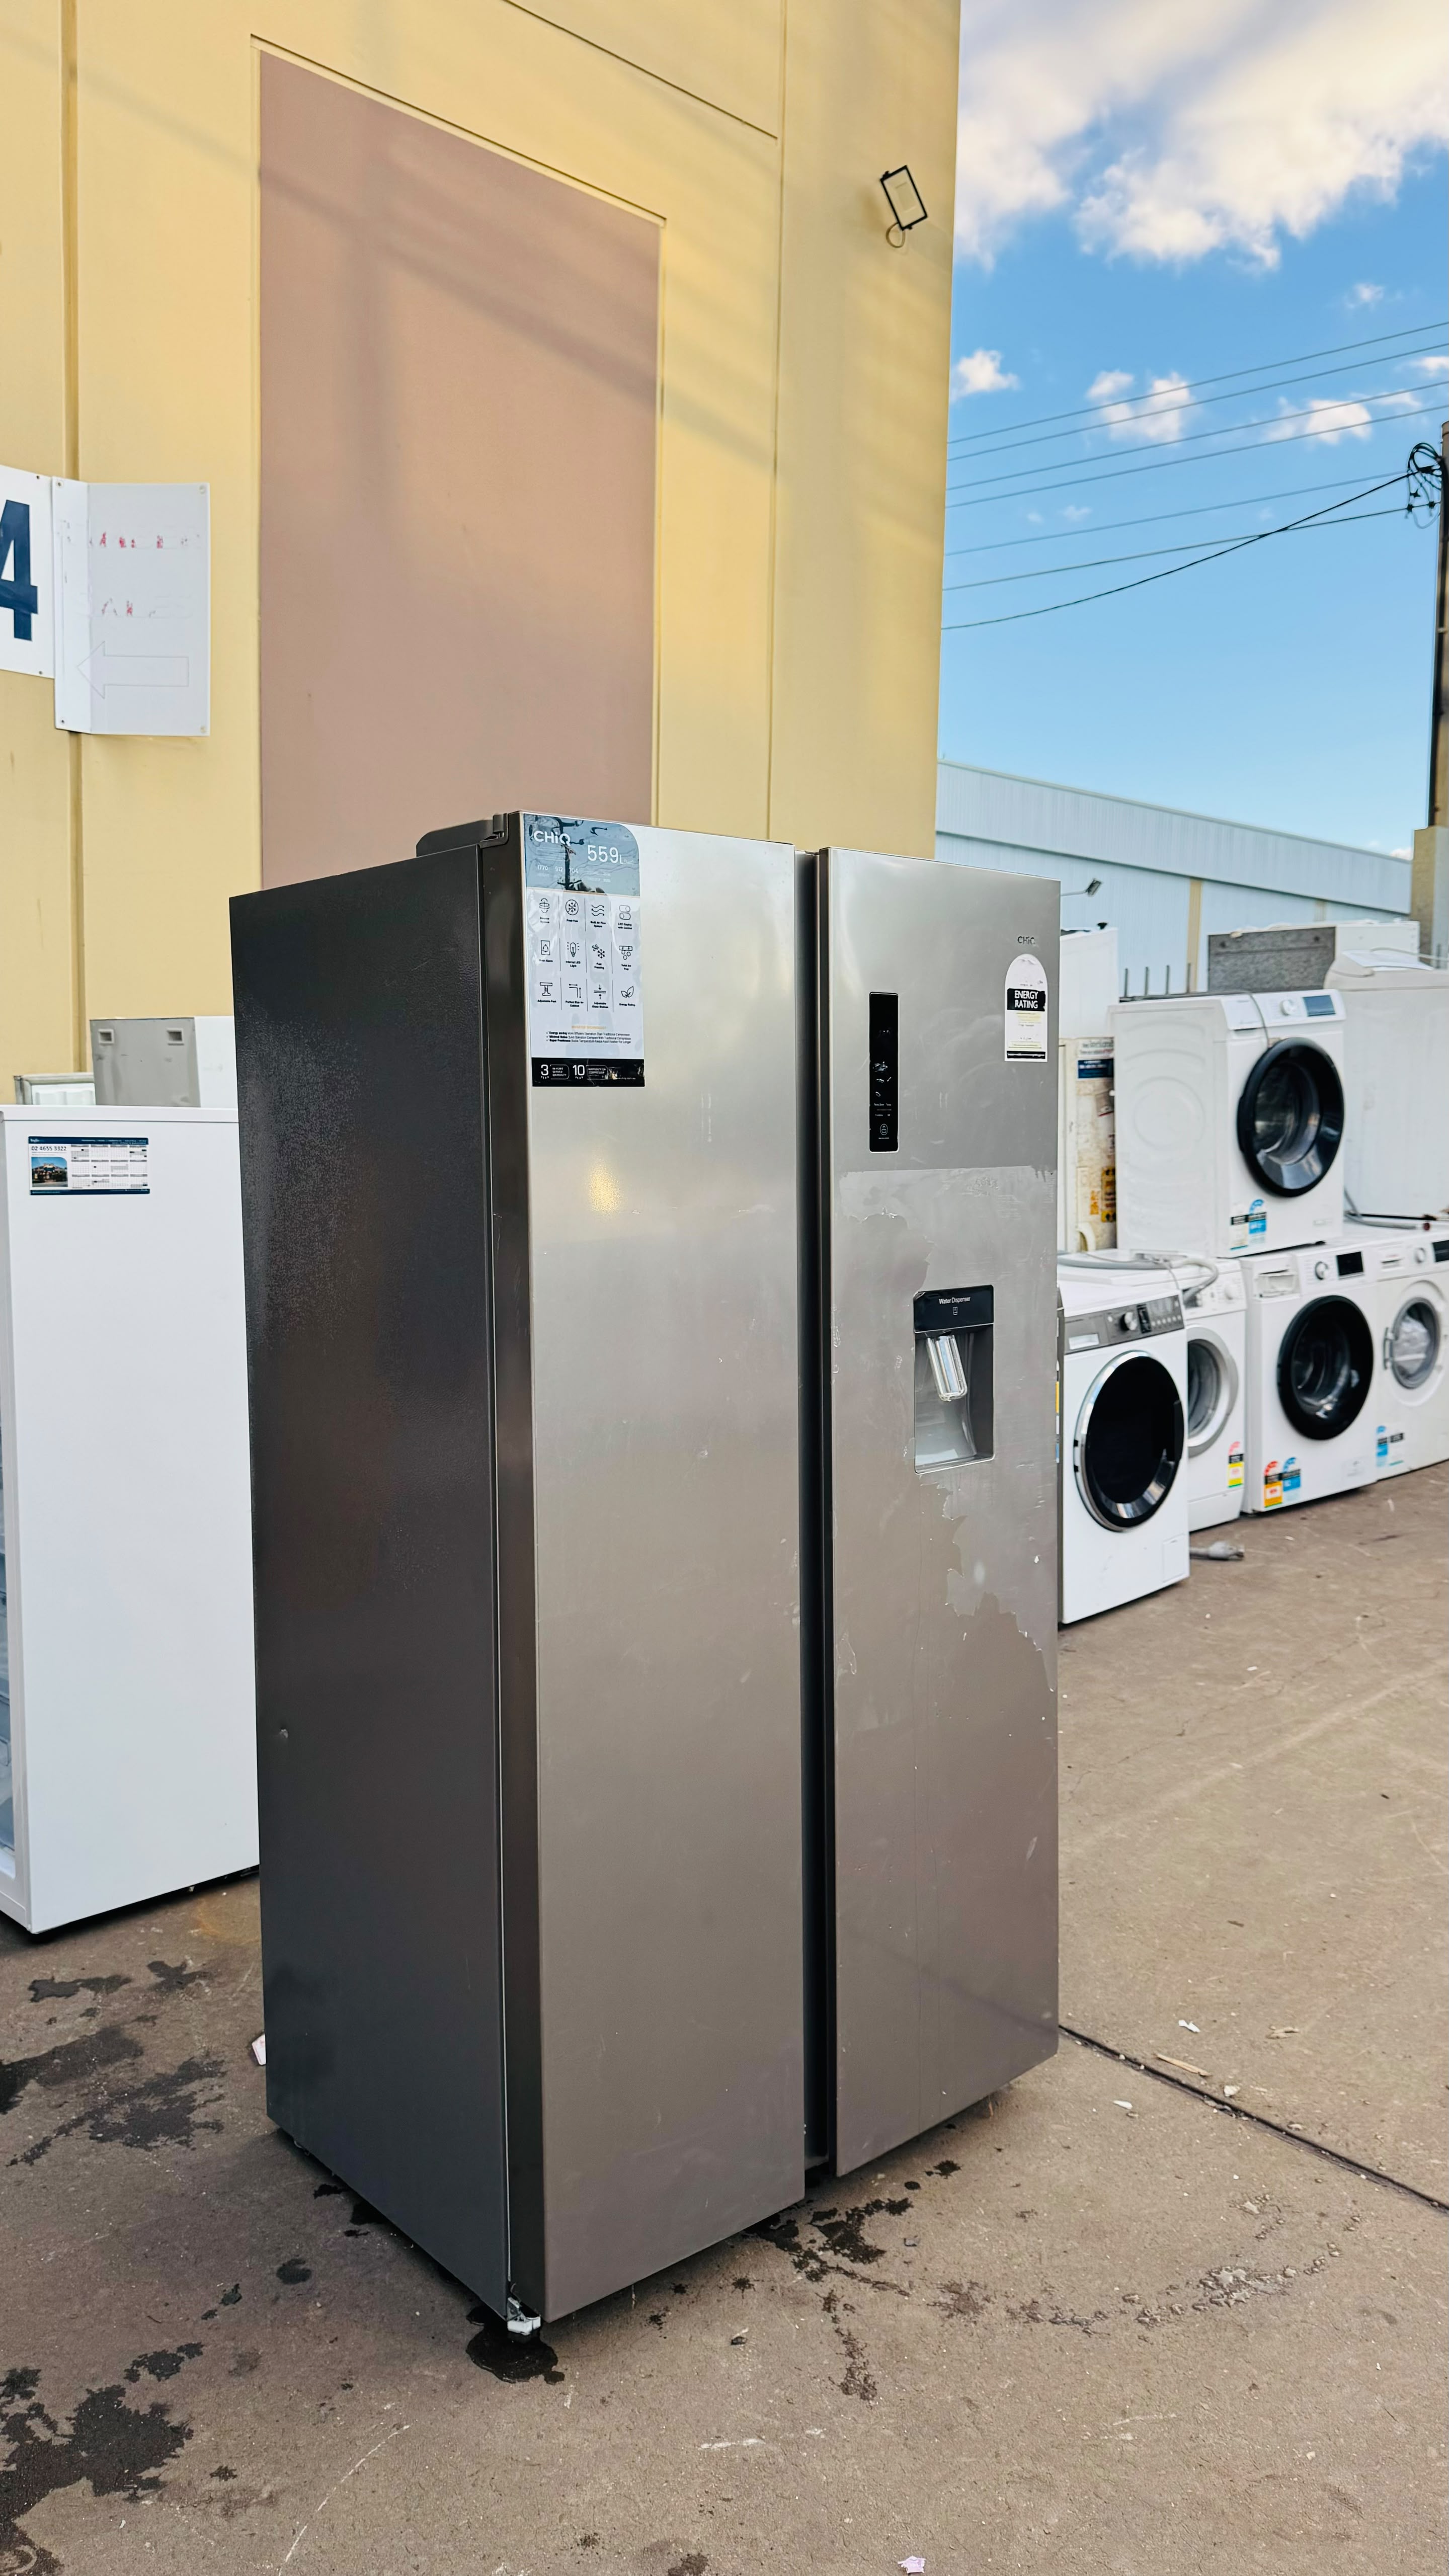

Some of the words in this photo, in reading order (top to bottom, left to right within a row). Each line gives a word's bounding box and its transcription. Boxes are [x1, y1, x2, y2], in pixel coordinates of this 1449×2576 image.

[533, 830, 571, 846] CHiQ
[1014, 990, 1038, 1000] ENERGY
[1015, 1000, 1038, 1009] RATING
[541, 1064, 549, 1076] 3
[573, 1065, 585, 1076] 10
